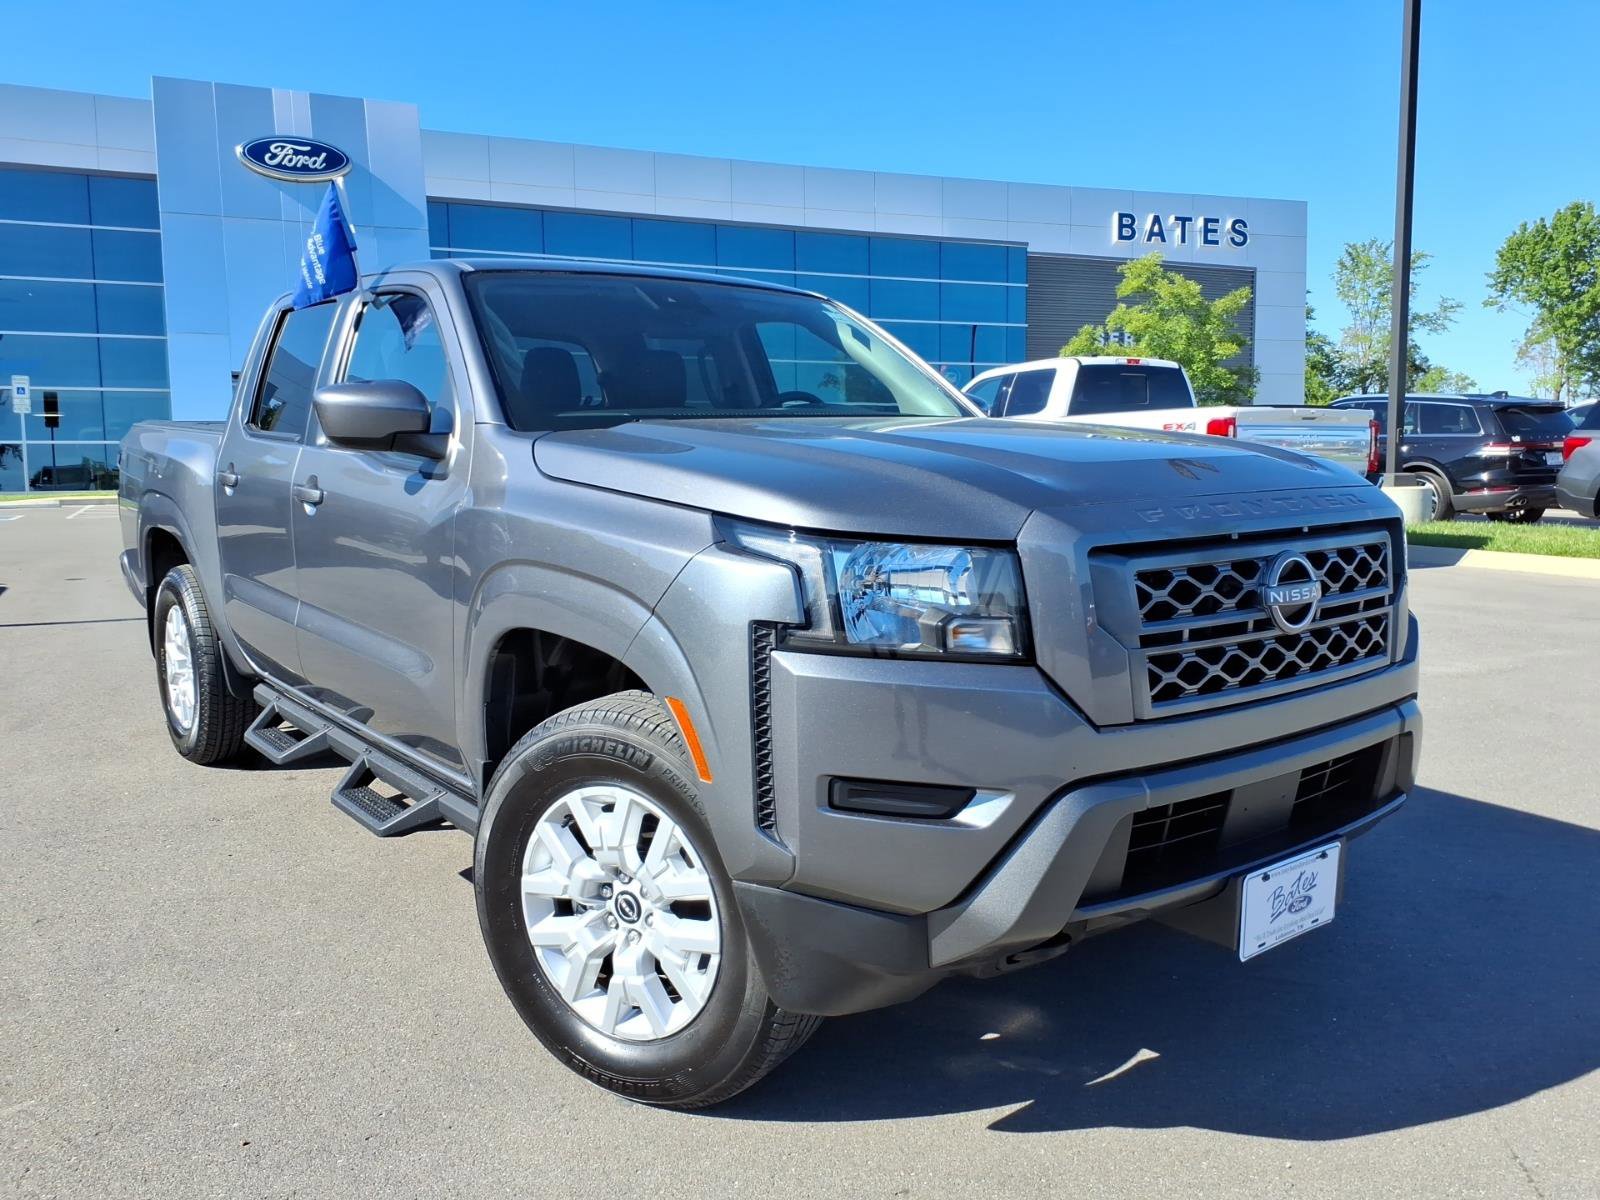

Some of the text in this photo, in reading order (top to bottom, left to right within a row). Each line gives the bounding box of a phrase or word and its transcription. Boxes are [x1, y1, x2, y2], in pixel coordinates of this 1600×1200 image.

[264, 142, 327, 170] Ford
[1112, 211, 1249, 248] BATES
[313, 233, 326, 255] Blue
[1270, 584, 1319, 603] NISSA
[556, 738, 650, 767] MICHELIN
